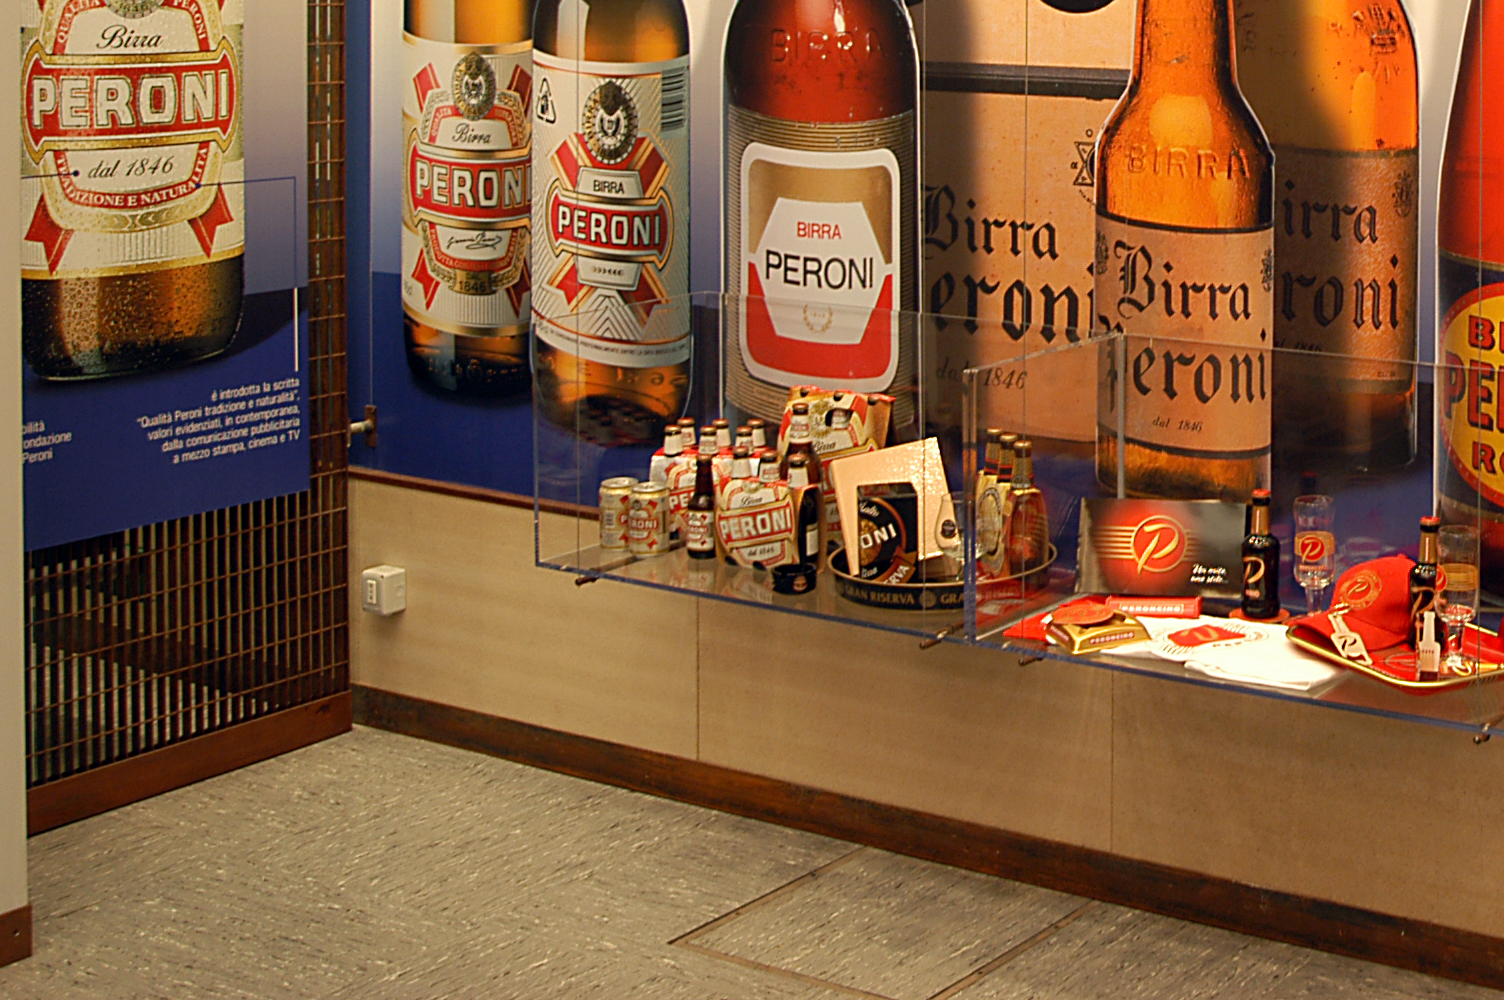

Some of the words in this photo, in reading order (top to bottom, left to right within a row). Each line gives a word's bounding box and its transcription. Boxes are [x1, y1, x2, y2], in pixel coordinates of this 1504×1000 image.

[97, 24, 163, 50] Birra
[31, 71, 229, 129] PERONI
[452, 122, 491, 144] Birra
[88, 160, 120, 179] dal
[126, 156, 174, 177] 1846
[1127, 145, 1250, 180] BIRRA
[56, 154, 124, 207] TRADIZIONE
[127, 194, 138, 207] E
[593, 179, 625, 195] BIRRA
[923, 184, 1059, 261] Birra
[1283, 179, 1379, 244] irra
[557, 209, 661, 246] PERONI
[796, 221, 842, 240] BIRRA
[765, 250, 874, 290] PERONI
[1114, 240, 1251, 321] Birra
[983, 367, 1027, 389] 1846
[1152, 416, 1170, 428] dal
[1178, 418, 1203, 432] 1846
[248, 434, 277, 450] cinema
[288, 429, 300, 441] TV
[720, 503, 791, 541] PERONI
[871, 589, 914, 605] RISERVA
